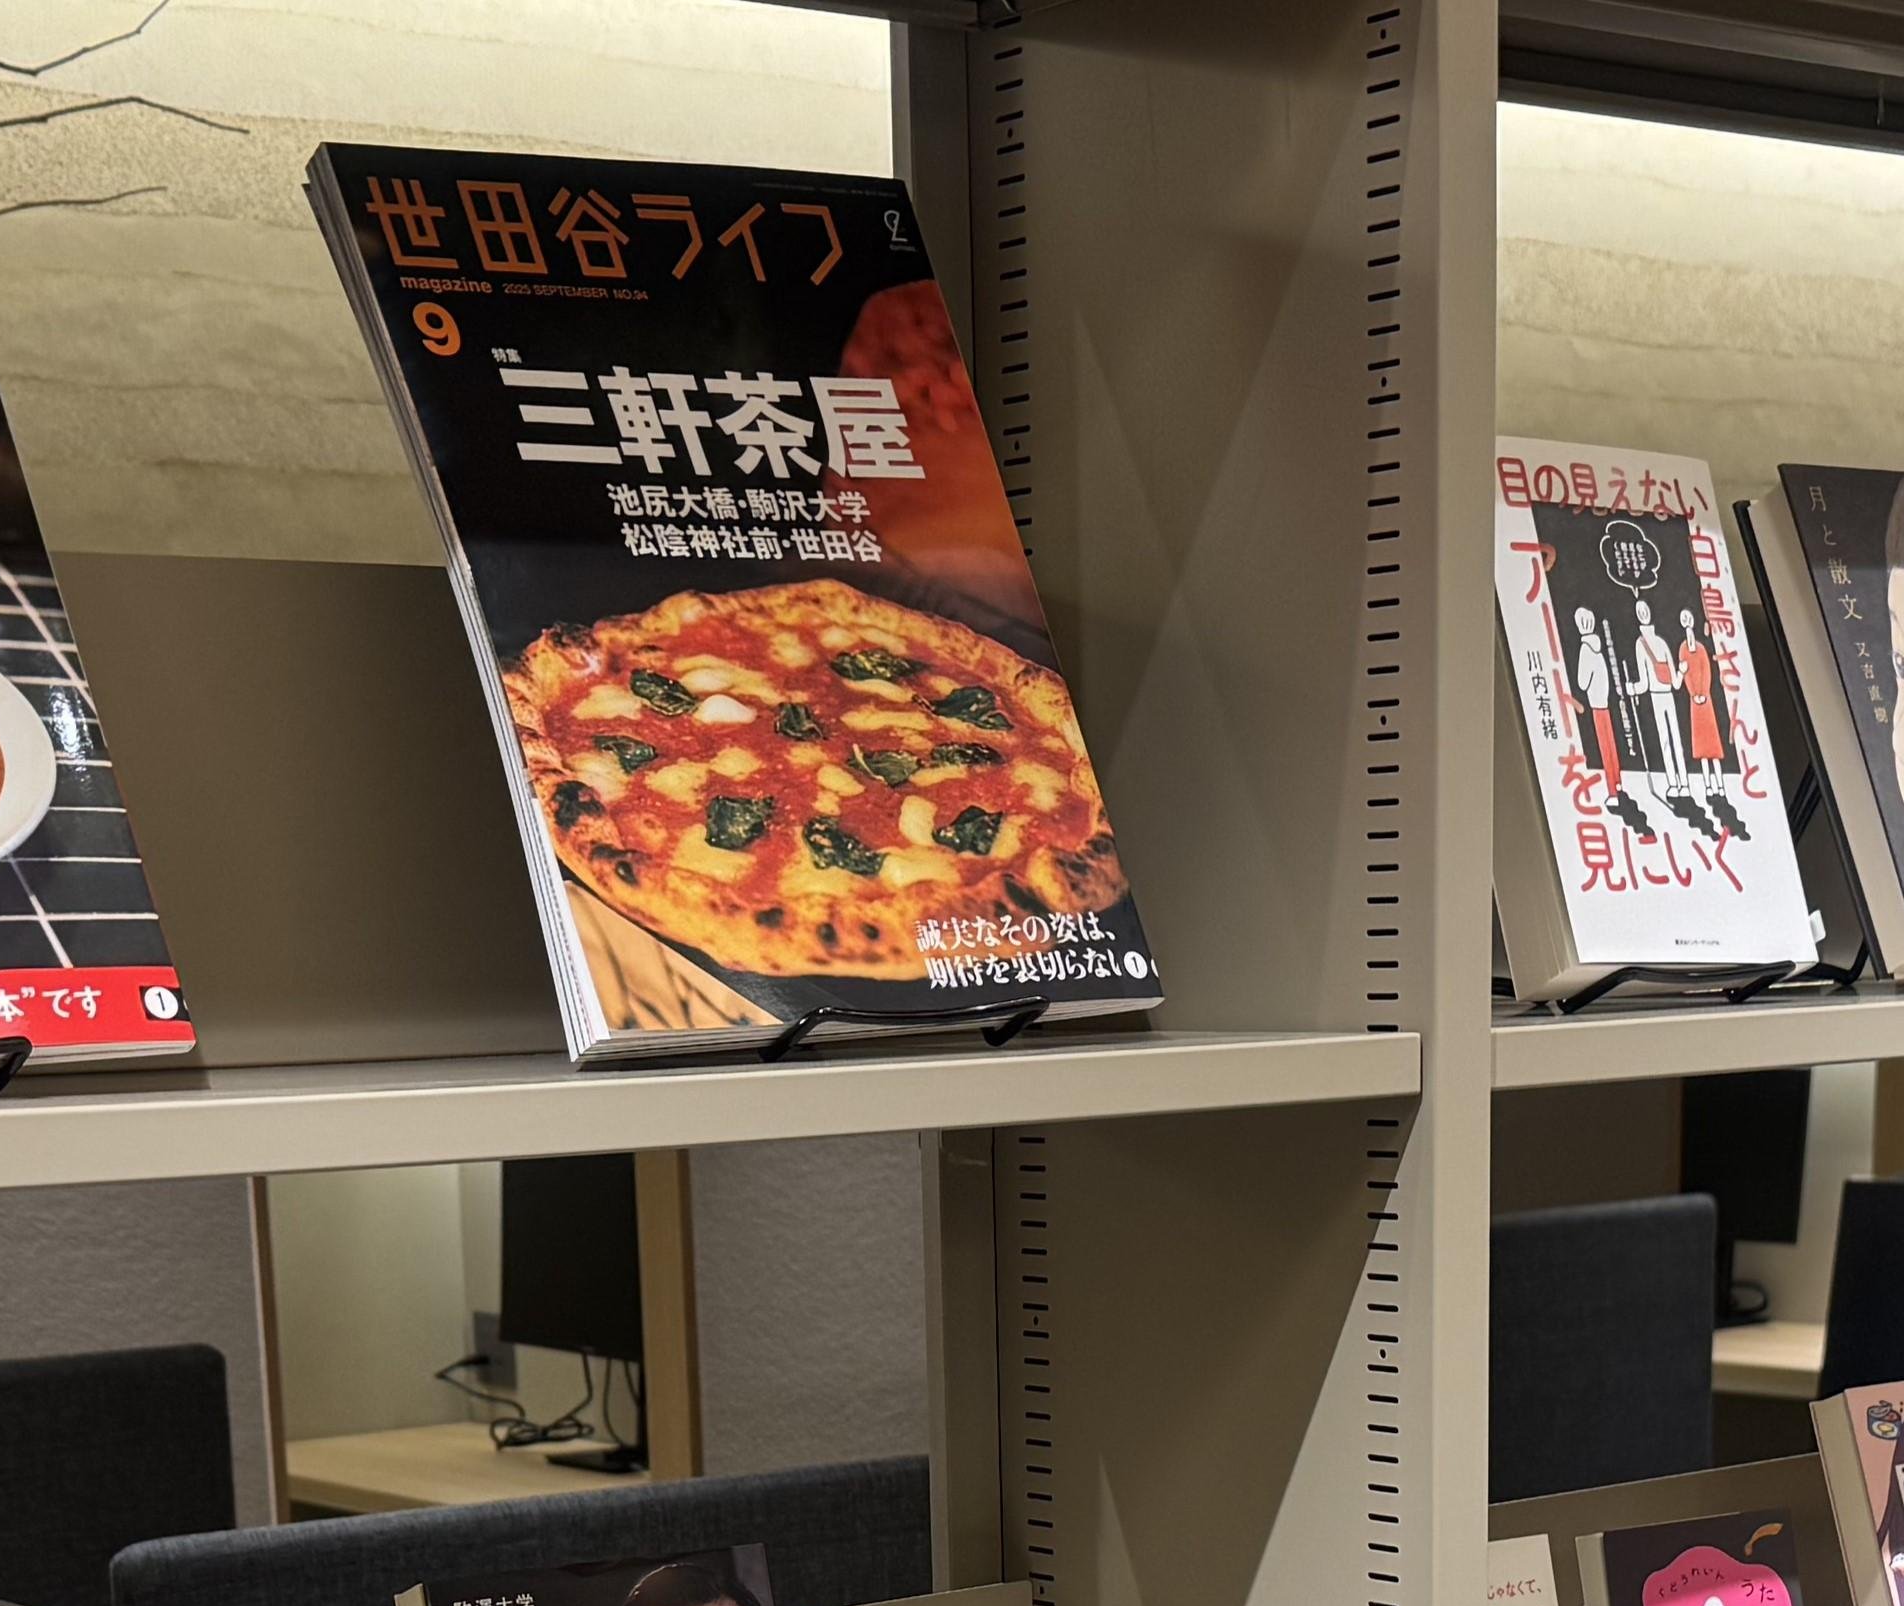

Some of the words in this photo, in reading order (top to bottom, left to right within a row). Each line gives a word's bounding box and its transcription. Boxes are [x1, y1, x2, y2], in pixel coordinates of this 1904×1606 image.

[366, 175, 845, 287] 世田谷ライフ
[399, 274, 493, 294] magazine
[411, 301, 462, 357] 9
[491, 347, 523, 364] 特集
[499, 365, 926, 481] 三軒茶屋
[606, 481, 872, 524] 池尻大橋・駒沢大学
[1496, 457, 1709, 521] 目の見えない
[621, 523, 883, 564] 松陰神社前・世田谷
[1807, 485, 1864, 621] 月と散文
[1687, 522, 1768, 799] 白鳥さんと
[1526, 650, 1560, 740] 川内有緒
[1576, 820, 1744, 893] 見にいく
[913, 911, 1116, 953] 誠実なその姿は、
